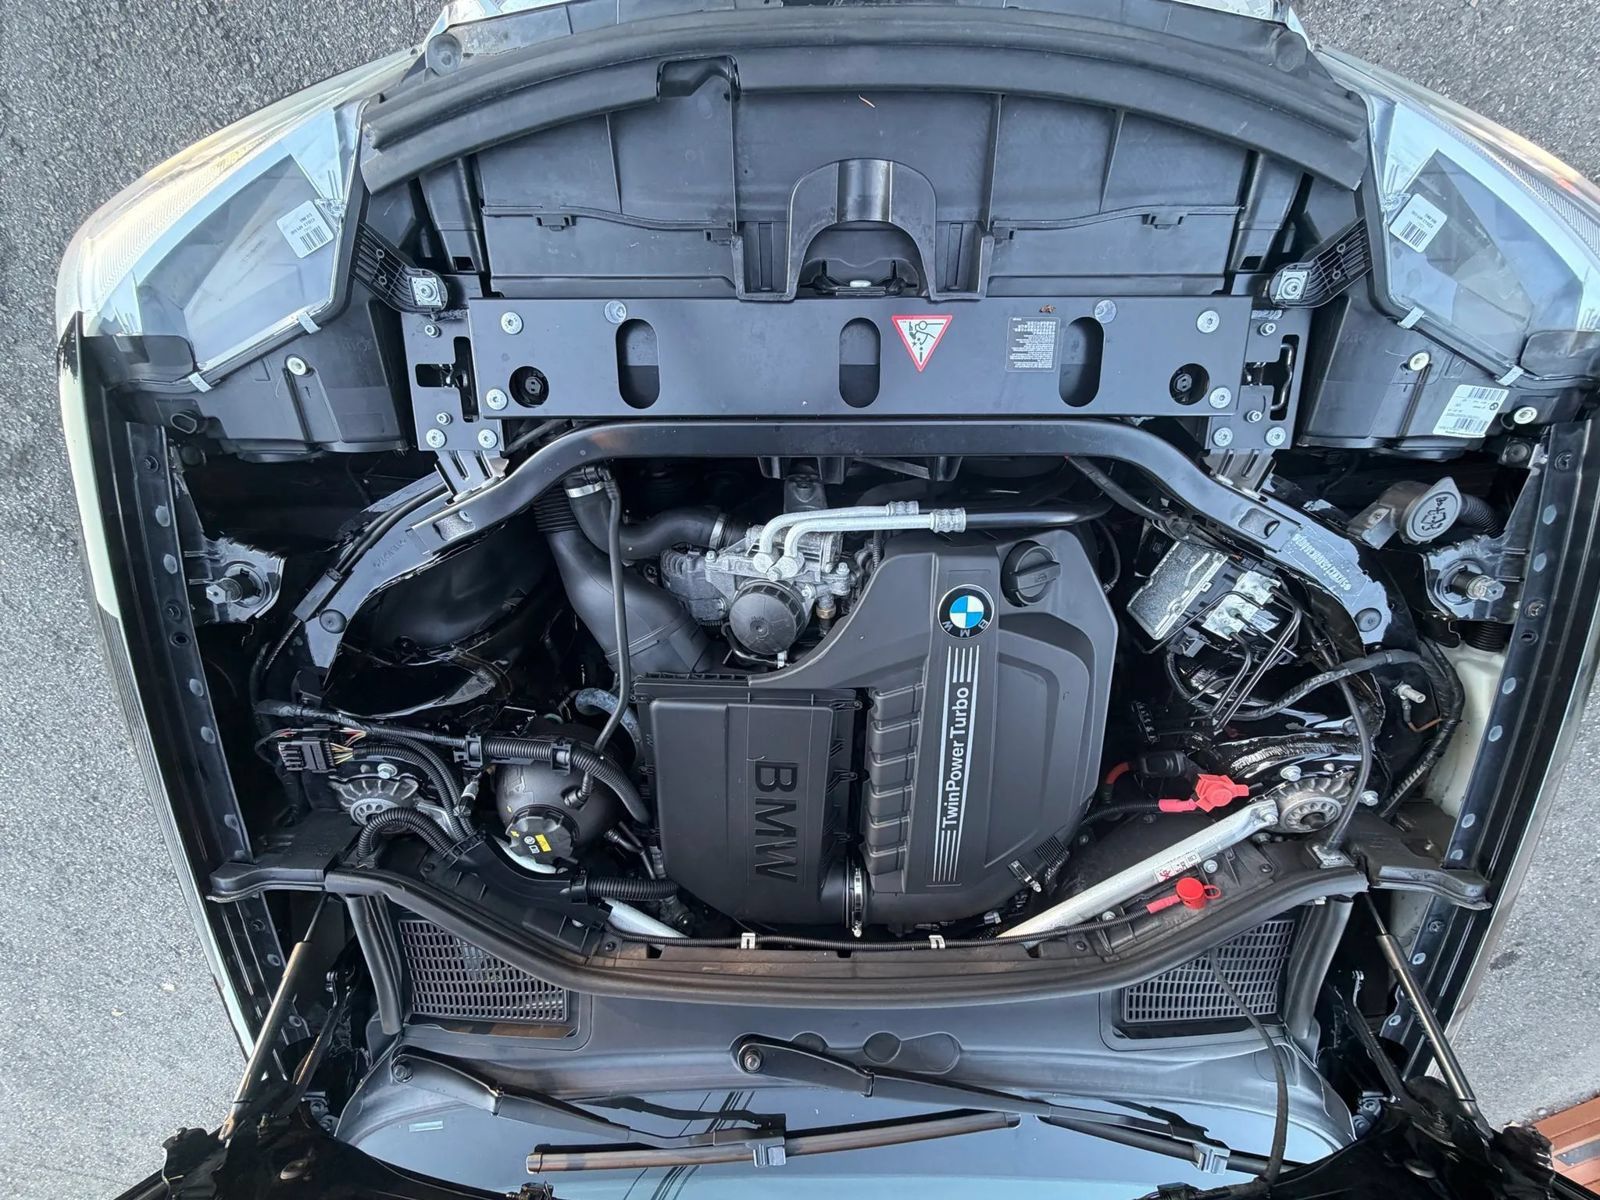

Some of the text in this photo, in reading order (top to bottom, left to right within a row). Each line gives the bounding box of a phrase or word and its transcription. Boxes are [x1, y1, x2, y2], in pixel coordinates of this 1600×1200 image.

[942, 619, 988, 637] BMW
[942, 687, 969, 828] TwinPower Turbo
[755, 761, 798, 883] BMW
